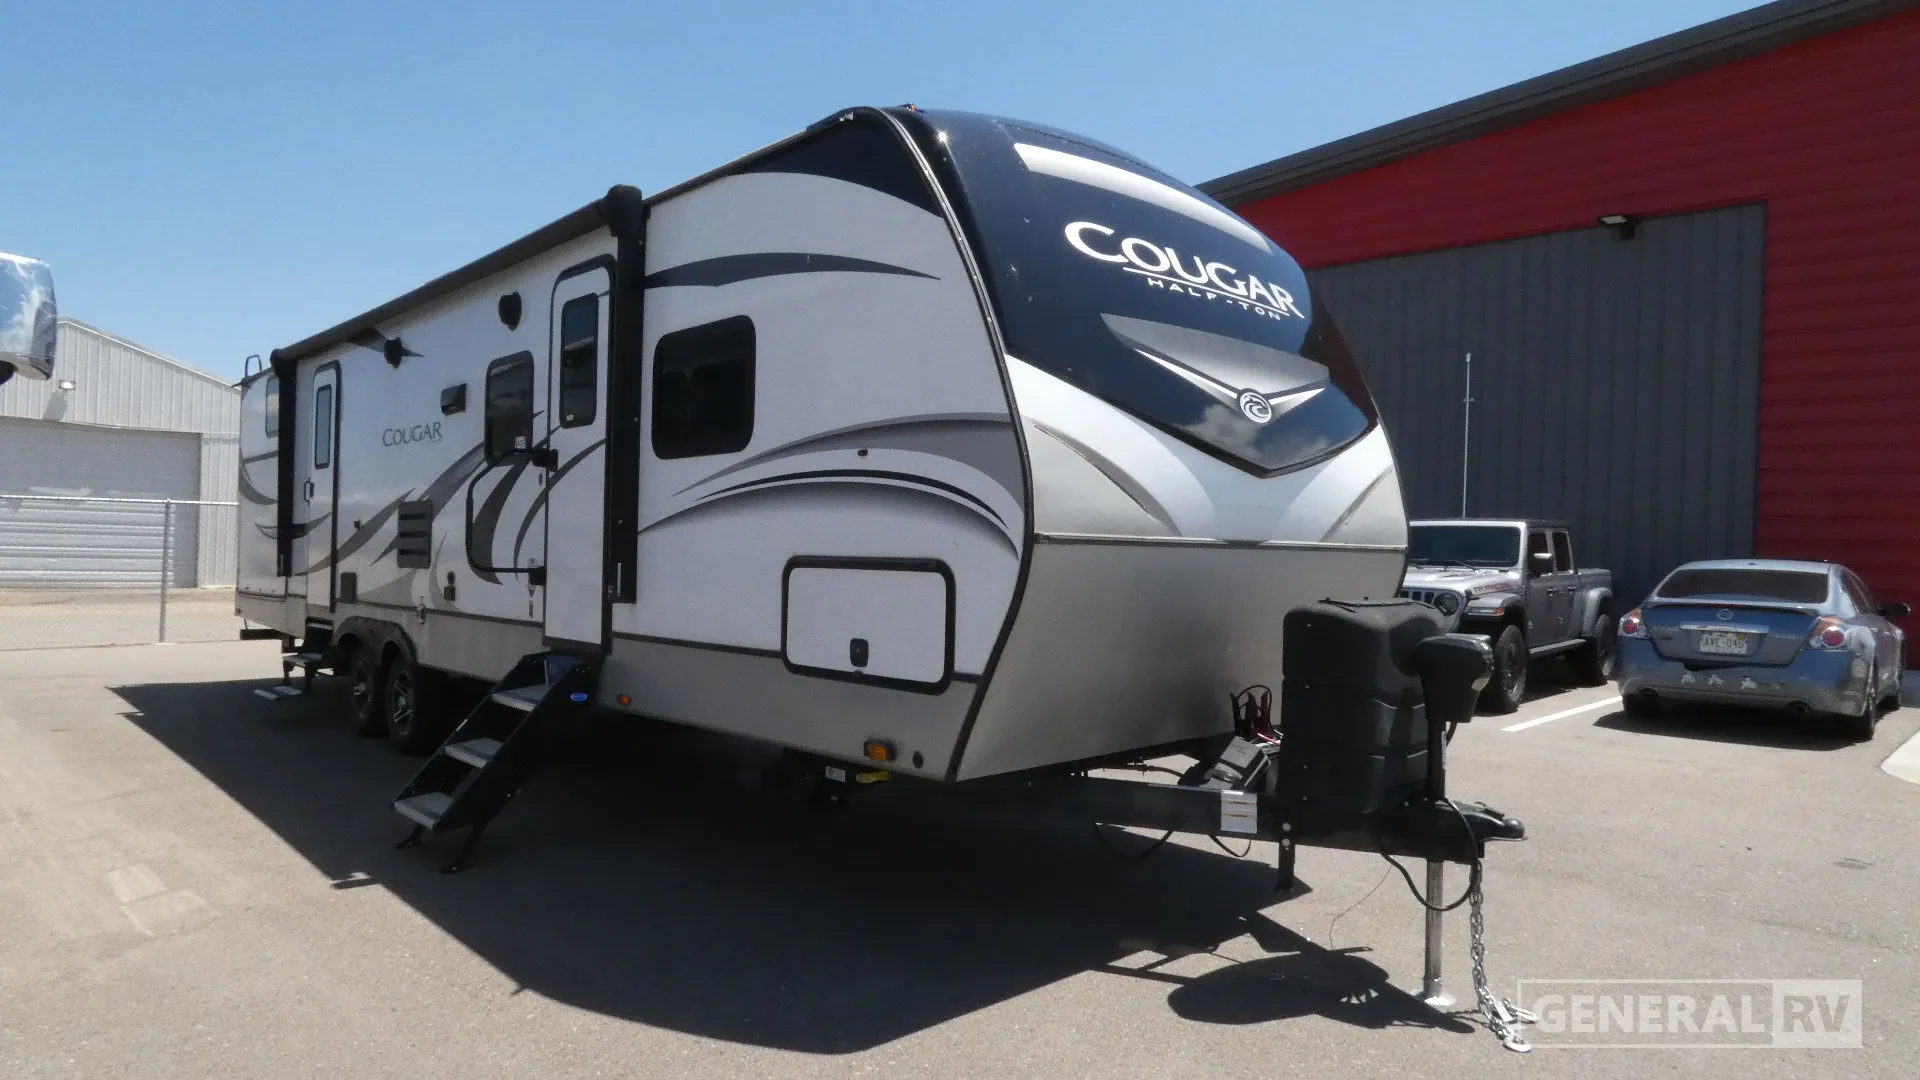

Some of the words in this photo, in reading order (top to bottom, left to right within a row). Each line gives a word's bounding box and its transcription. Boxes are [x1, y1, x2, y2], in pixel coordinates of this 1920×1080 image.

[1064, 221, 1305, 319] COUGAR
[1147, 278, 1281, 321] HALF-TON
[382, 421, 443, 447] COUGAR
